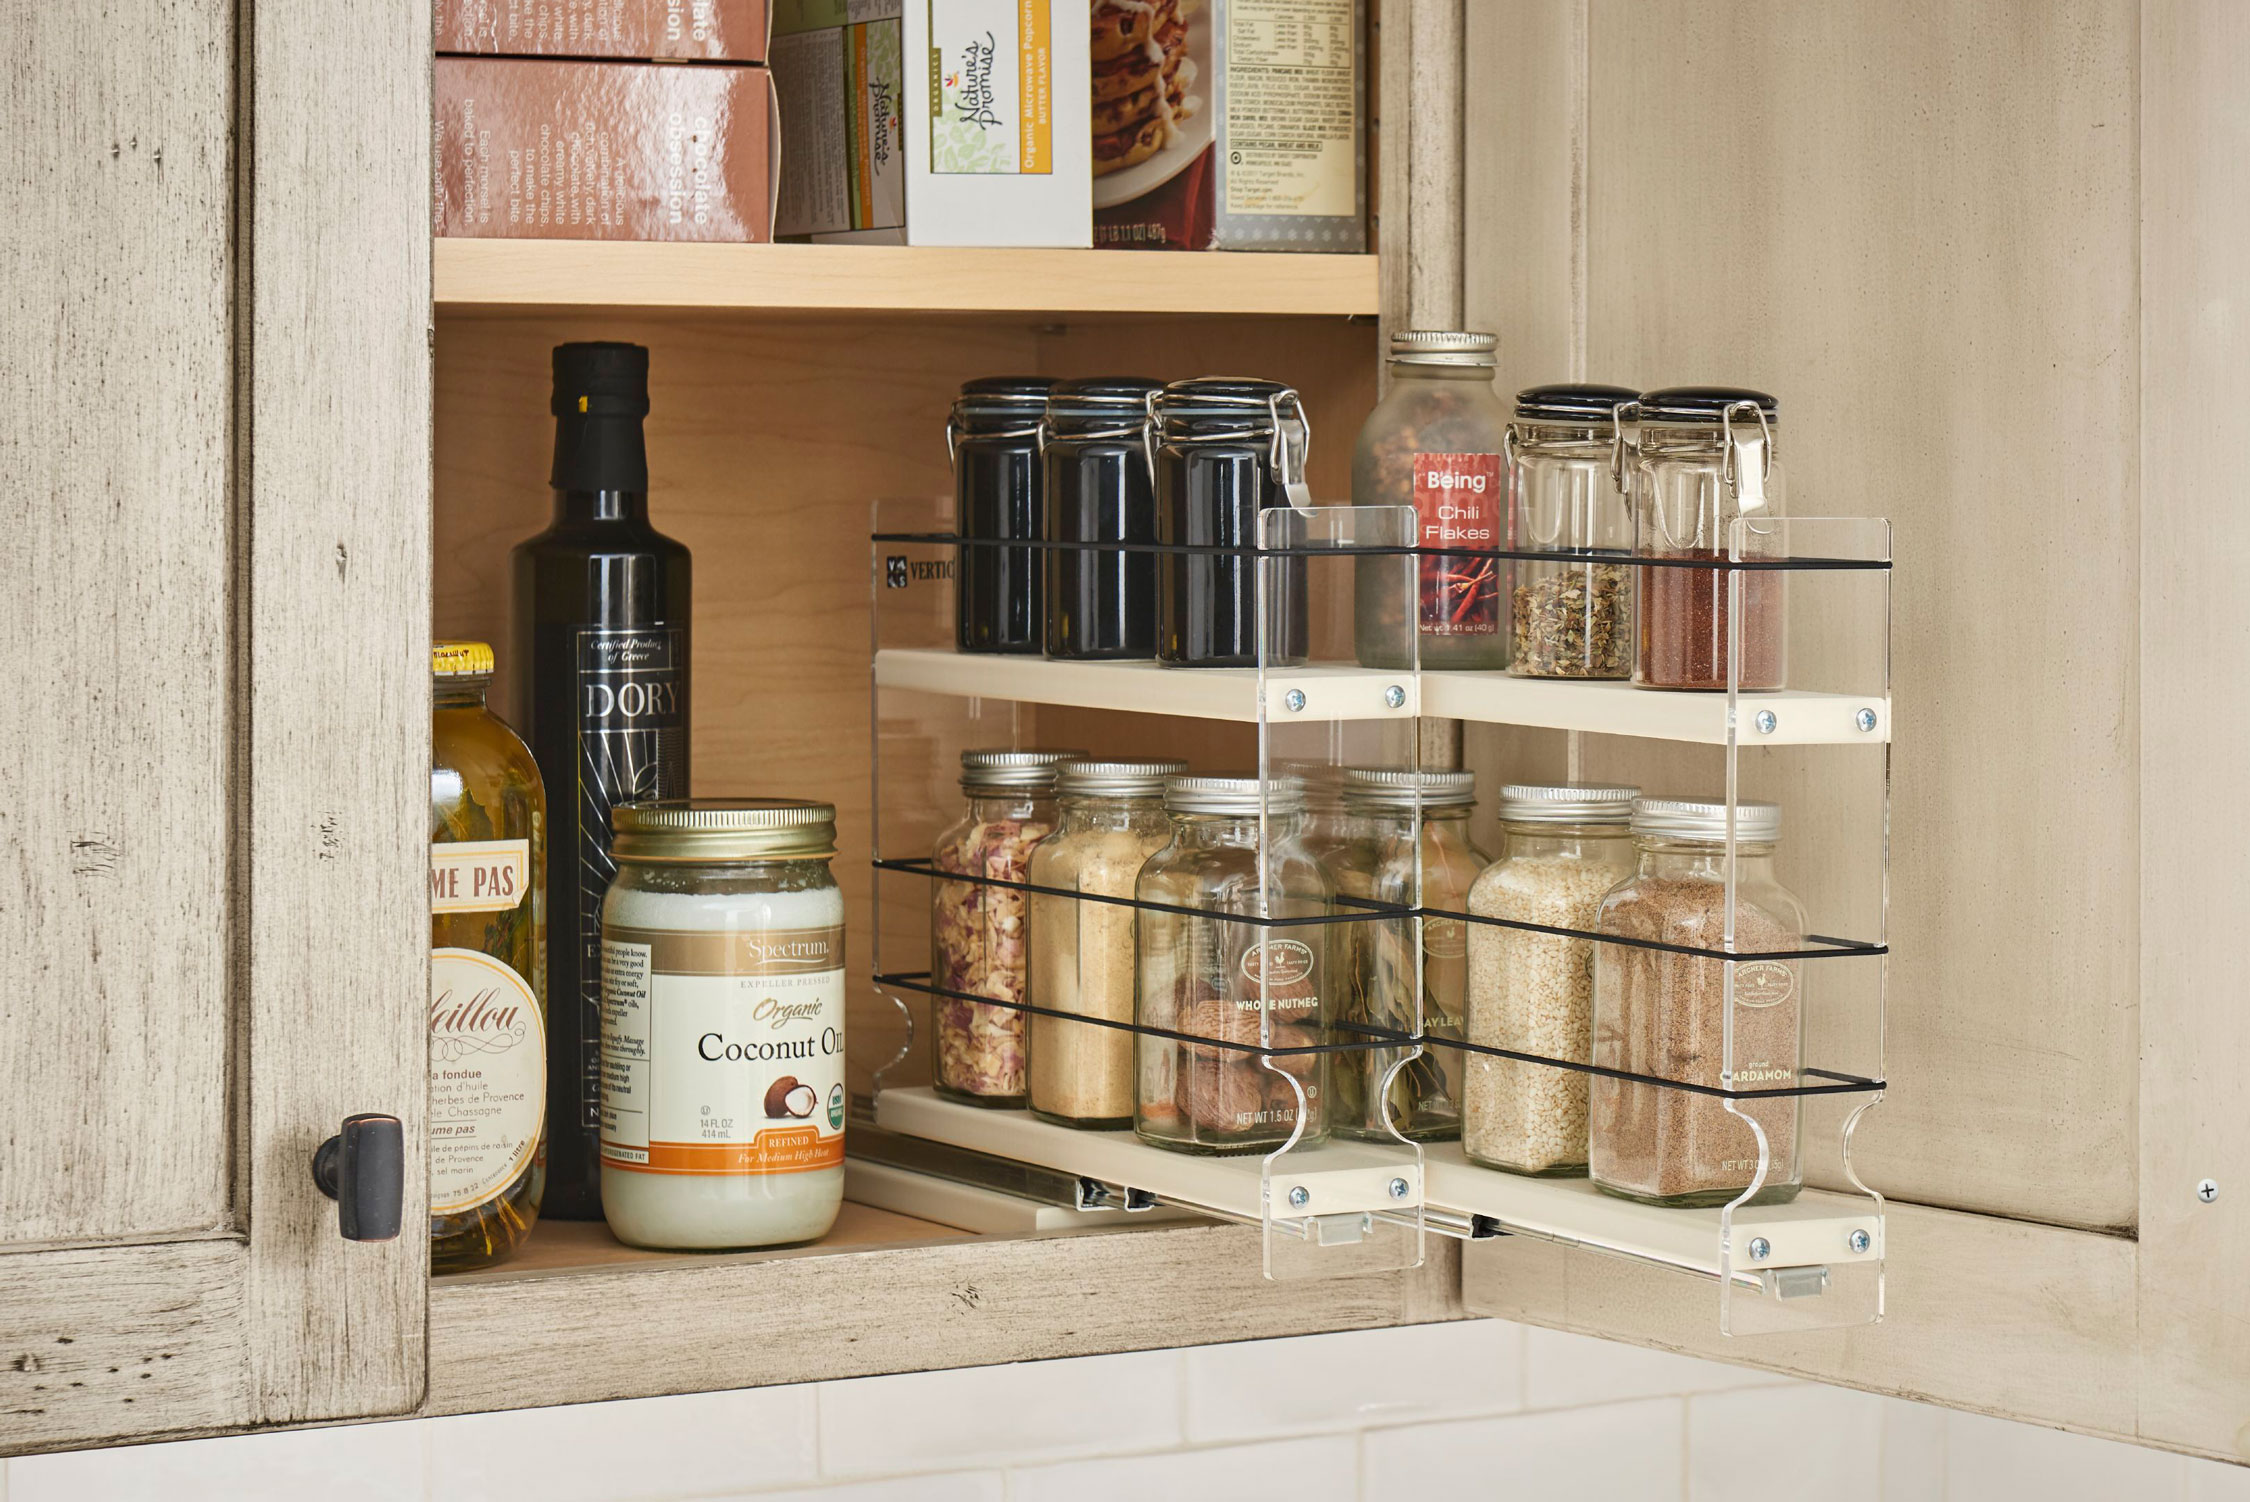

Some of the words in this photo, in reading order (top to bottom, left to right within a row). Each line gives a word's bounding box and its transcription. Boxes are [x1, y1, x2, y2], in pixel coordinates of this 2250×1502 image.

[693, 0, 710, 41] late
[1023, 1, 1035, 49] Popcorn
[1038, 47, 1046, 85] FLAVOR
[932, 53, 940, 111] ORGANICS
[955, 41, 981, 123] Nature's
[1023, 54, 1034, 119] Microwave
[1038, 86, 1047, 124] BUTTER
[465, 99, 475, 140] baked
[435, 121, 445, 142] We
[465, 143, 475, 155] to
[480, 130, 490, 162] Each
[526, 149, 536, 161] to
[541, 124, 552, 186] chocolate
[1023, 122, 1036, 169] Organic
[509, 150, 521, 196] perfect
[668, 113, 685, 224] obsession
[693, 117, 711, 225] chocolate
[480, 166, 490, 209] morsel
[526, 165, 536, 200] make
[526, 203, 536, 224] the
[539, 190, 552, 226] chips,
[555, 190, 565, 224] white
[571, 199, 581, 225] with
[585, 197, 596, 225] dark
[480, 213, 490, 224] is
[1428, 471, 1486, 494] Being
[1438, 506, 1479, 520] Chili
[1426, 526, 1489, 540] Flakes
[591, 639, 630, 653] Certified
[608, 652, 618, 664] of
[621, 651, 649, 662] Greece
[585, 681, 681, 718] DORY
[473, 865, 514, 898] PAS
[631, 949, 647, 959] know.
[749, 939, 828, 962] Spectrum
[630, 959, 644, 969] good
[740, 979, 793, 989] EXPELLER
[797, 976, 831, 987] PRESSED
[636, 990, 647, 998] Oil
[1236, 999, 1276, 1011] WHOE
[1278, 996, 1319, 1010] NUTMEG
[752, 996, 823, 1029] Organic
[1423, 1017, 1440, 1028] AY
[697, 1032, 816, 1062] Coconut
[442, 1068, 482, 1080] fondue
[456, 1081, 489, 1092] d'huile
[432, 1094, 465, 1106] herbes
[468, 1094, 480, 1104] de
[483, 1091, 525, 1104] Provence
[447, 1106, 502, 1119] Chassagne
[1236, 1112, 1253, 1125] NET
[1254, 1111, 1268, 1124] WT
[1270, 1110, 1282, 1122] 1.5
[1284, 1108, 1294, 1121] OZ
[455, 1125, 476, 1136] pas
[700, 1118, 710, 1128] 14
[721, 1118, 734, 1128] OZ
[701, 1129, 717, 1139] 414
[769, 1135, 809, 1148] REFINED
[442, 1144, 452, 1152] de
[481, 1143, 490, 1151] de
[634, 1152, 646, 1161] FAT
[738, 1153, 754, 1164] For
[756, 1150, 793, 1163] Medium
[794, 1149, 813, 1162] High
[448, 1154, 484, 1164] Provence
[1720, 1160, 1737, 1171] NET
[1737, 1159, 1748, 1170] WT
[437, 1167, 448, 1176] sel
[451, 1167, 474, 1175] marin
